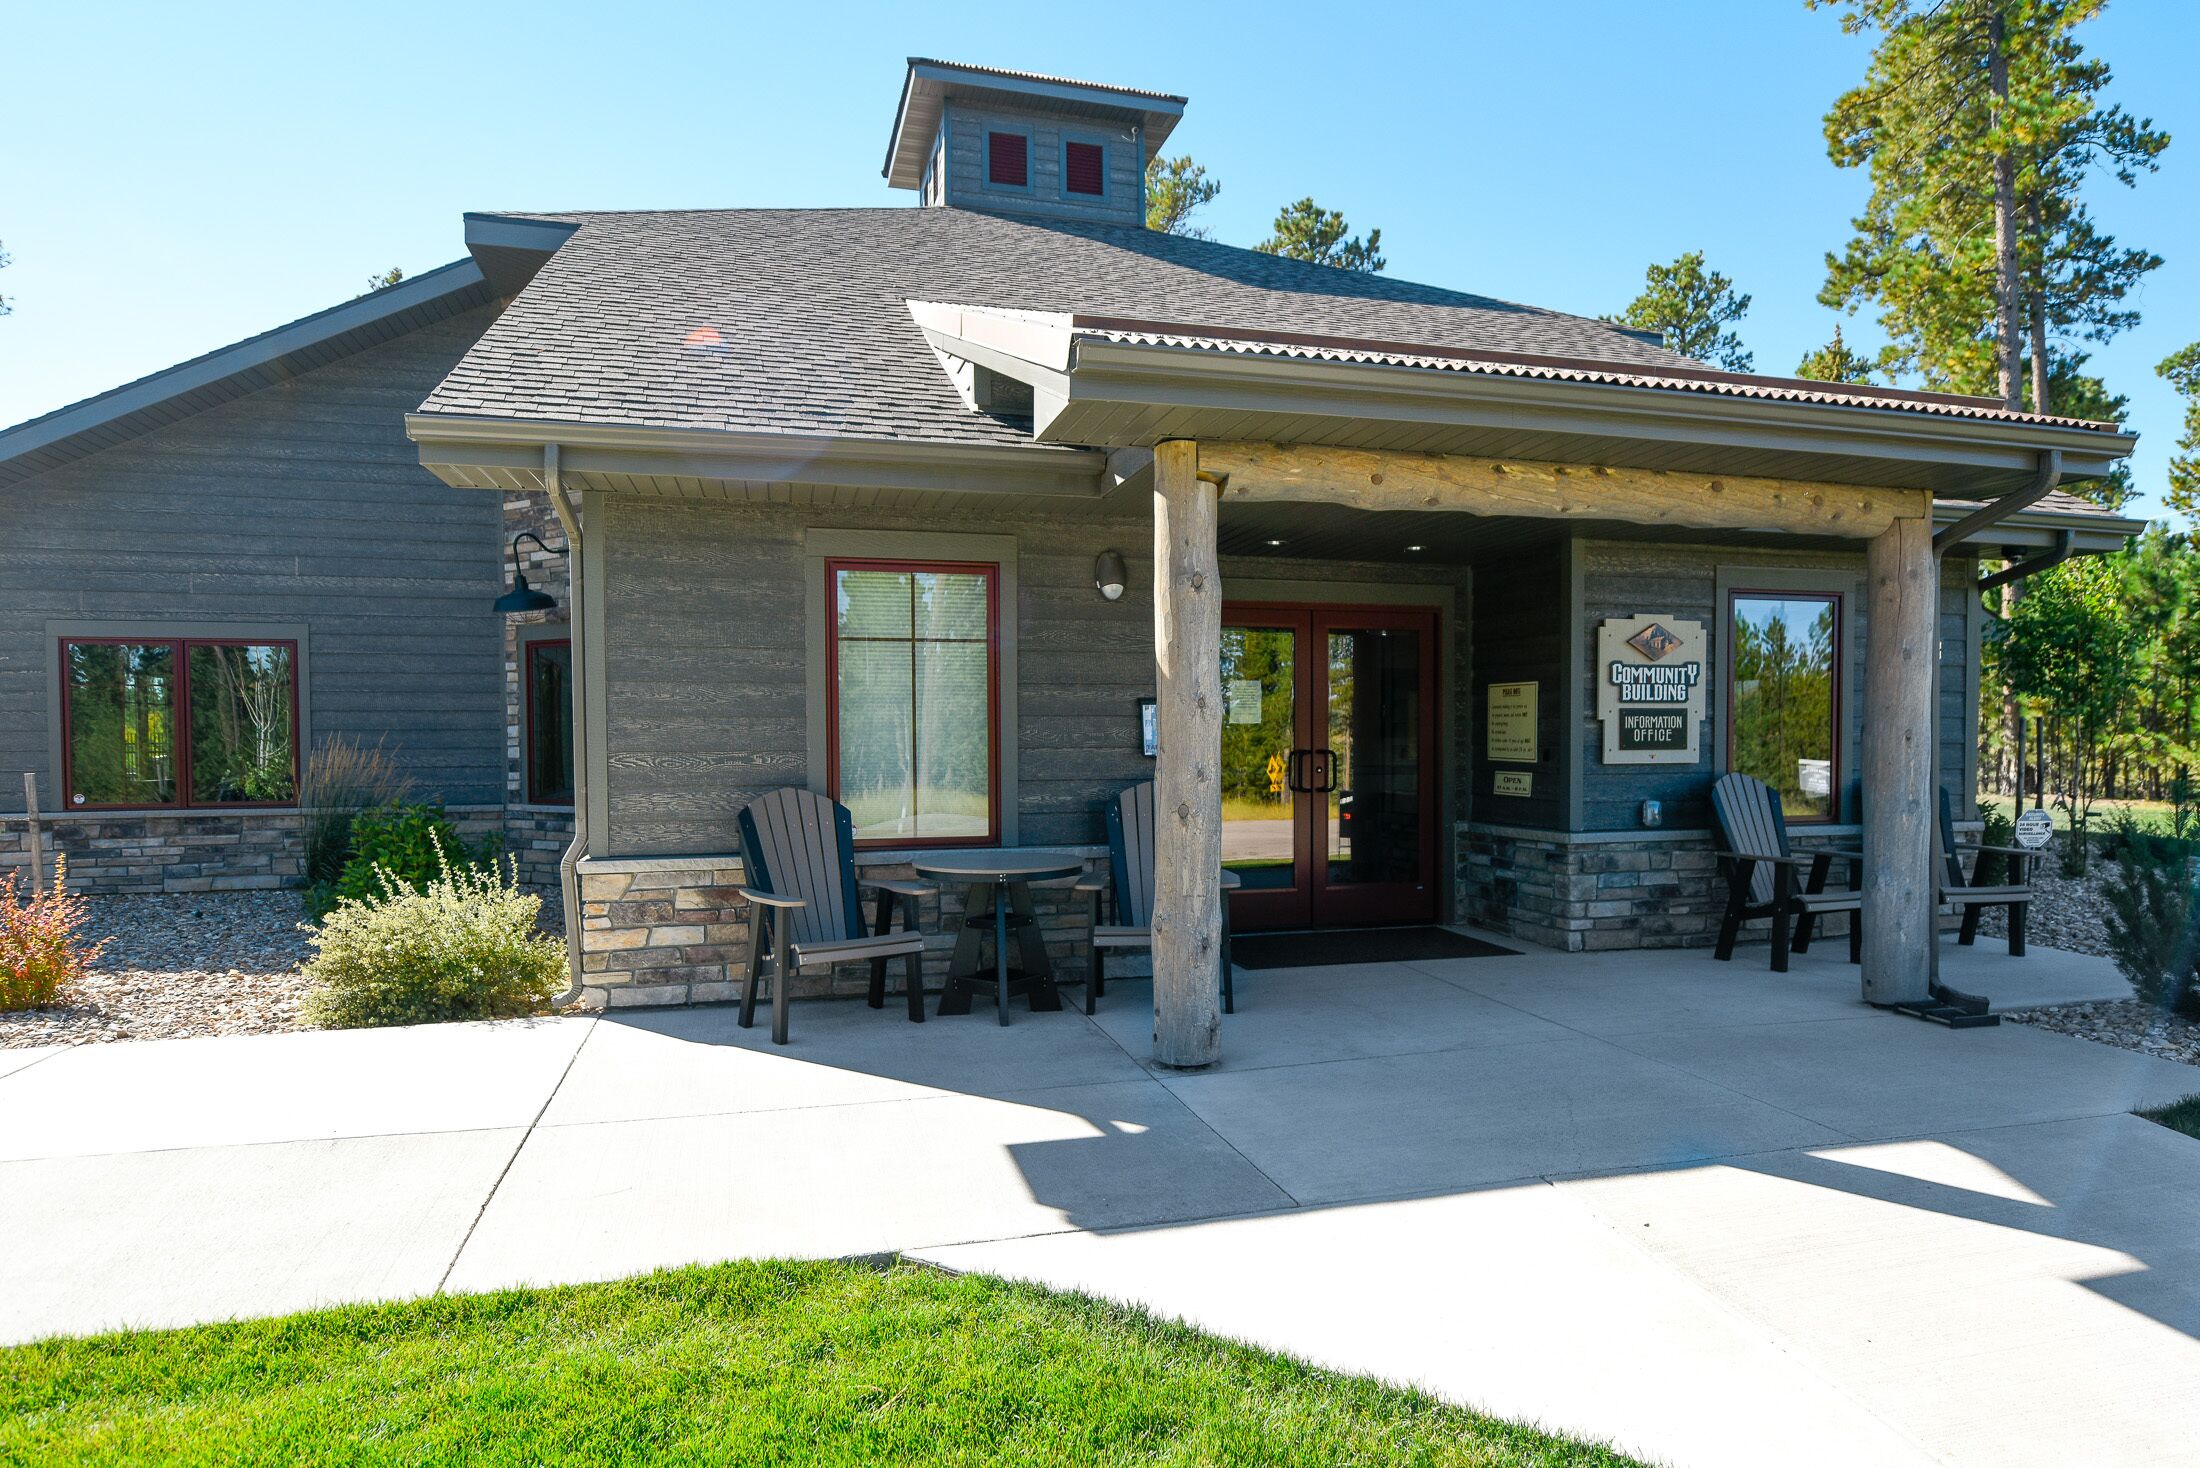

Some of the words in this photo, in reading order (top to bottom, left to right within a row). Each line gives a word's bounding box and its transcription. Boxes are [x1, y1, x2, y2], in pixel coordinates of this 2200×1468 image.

[1612, 663, 1698, 685] COMMUNITY
[1622, 684, 1686, 701] BUILDING
[1625, 715, 1683, 729] INFORMATION
[1633, 729, 1672, 742] OFFICE
[1503, 776, 1522, 784] OPEN
